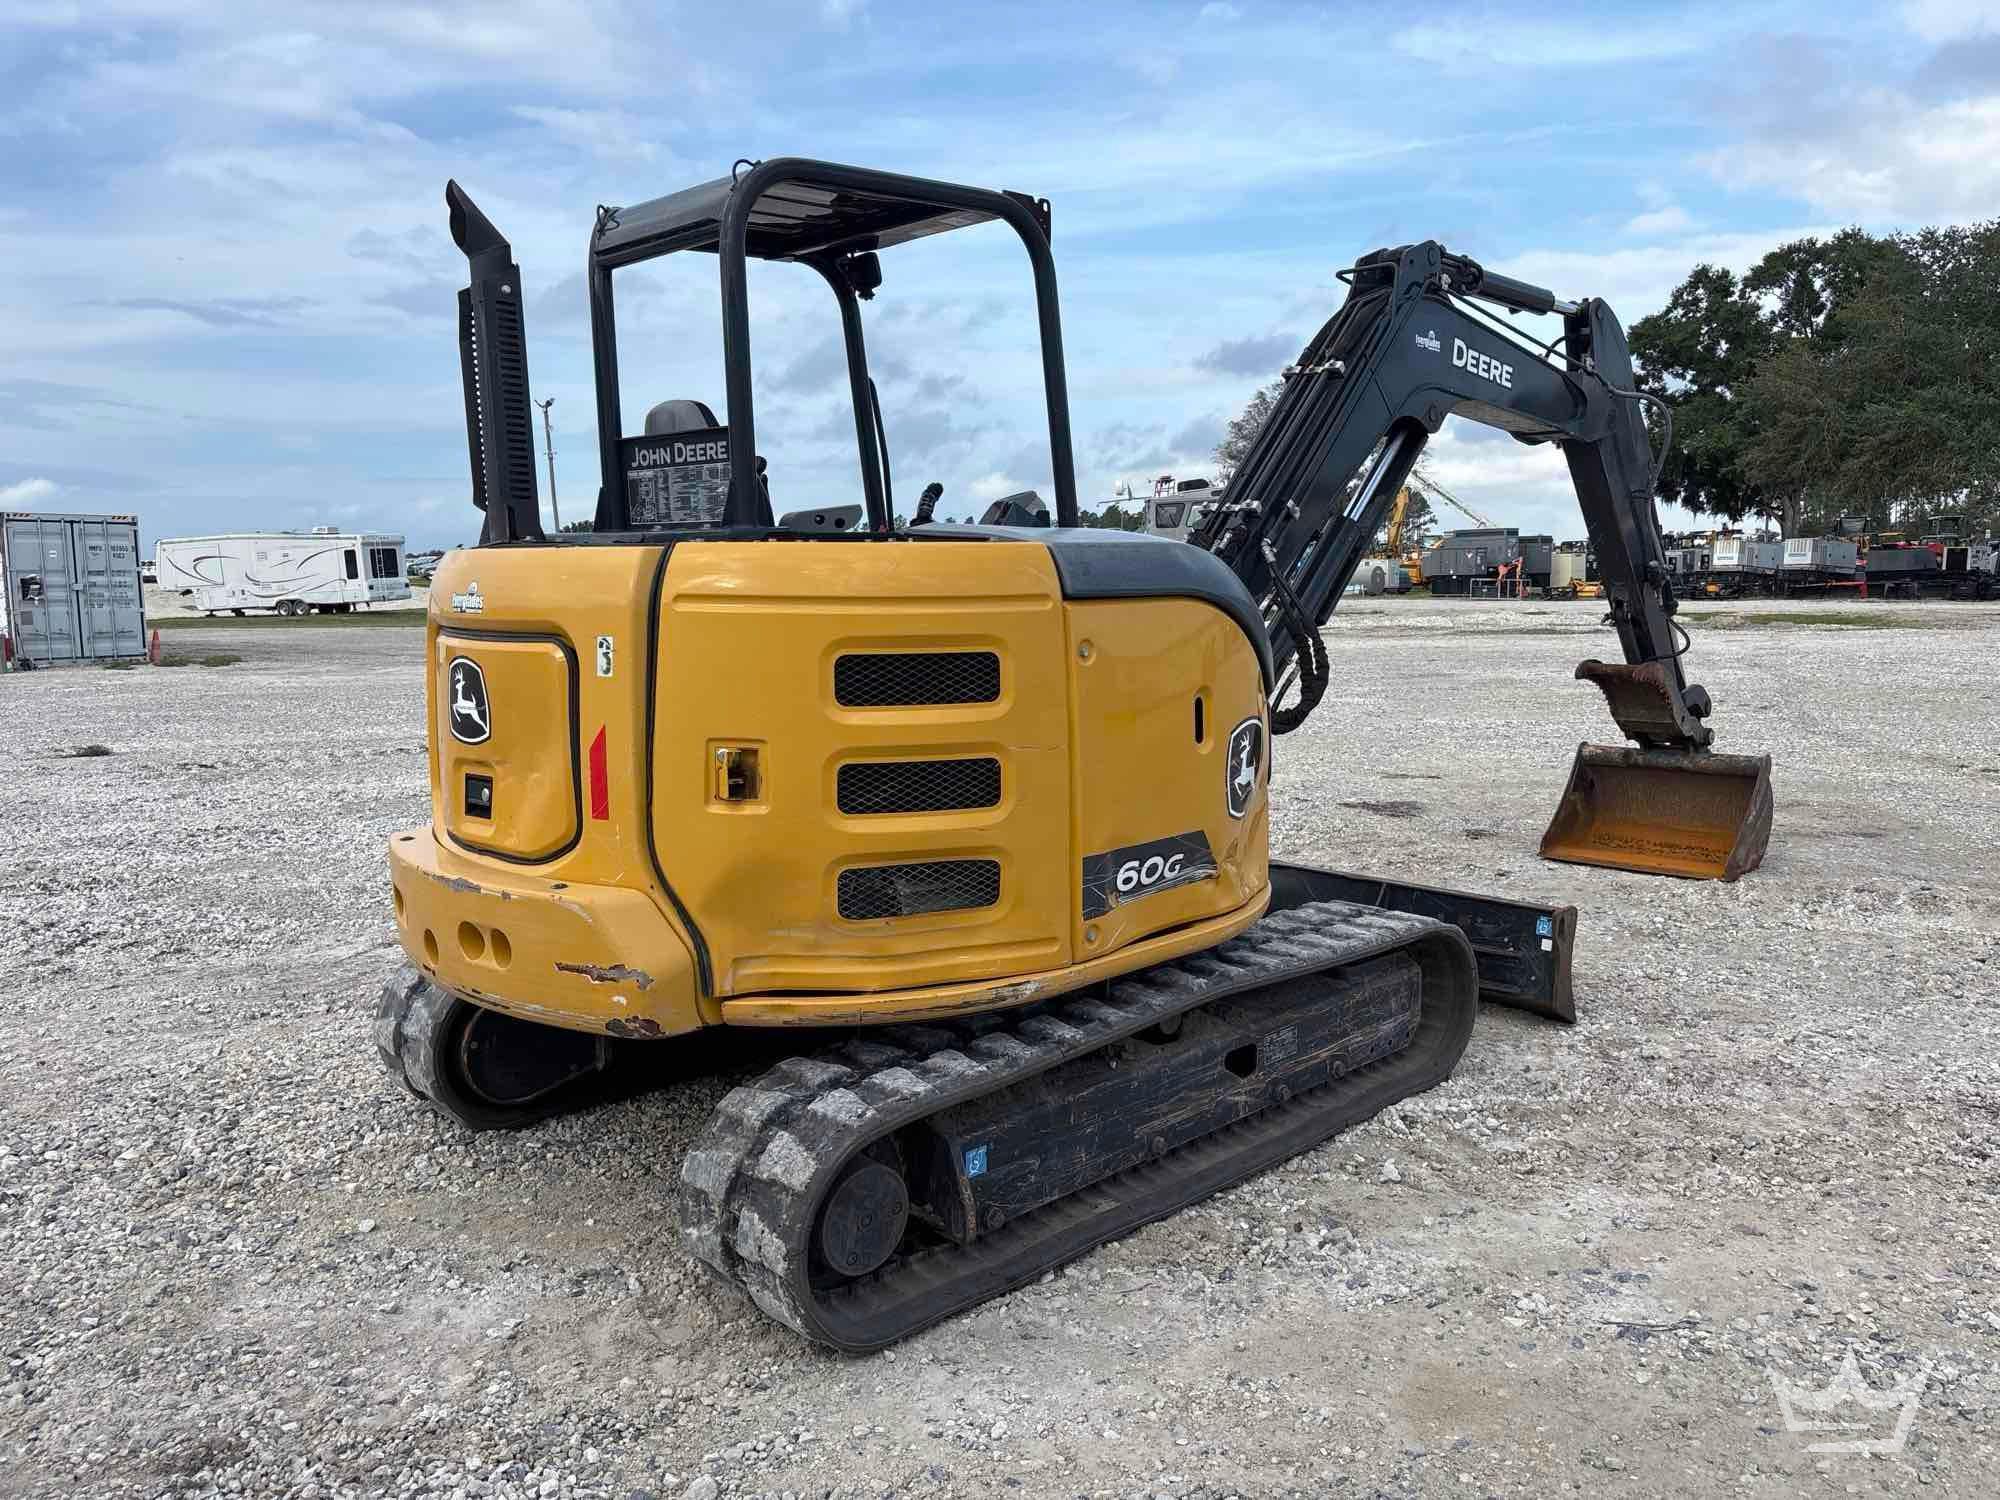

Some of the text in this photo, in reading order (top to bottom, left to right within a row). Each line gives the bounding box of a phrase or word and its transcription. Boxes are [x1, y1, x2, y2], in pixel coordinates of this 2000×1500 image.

[1452, 338, 1513, 388] DEERE
[632, 441, 728, 467] JOHN DEERE
[1116, 853, 1184, 892] 60G
